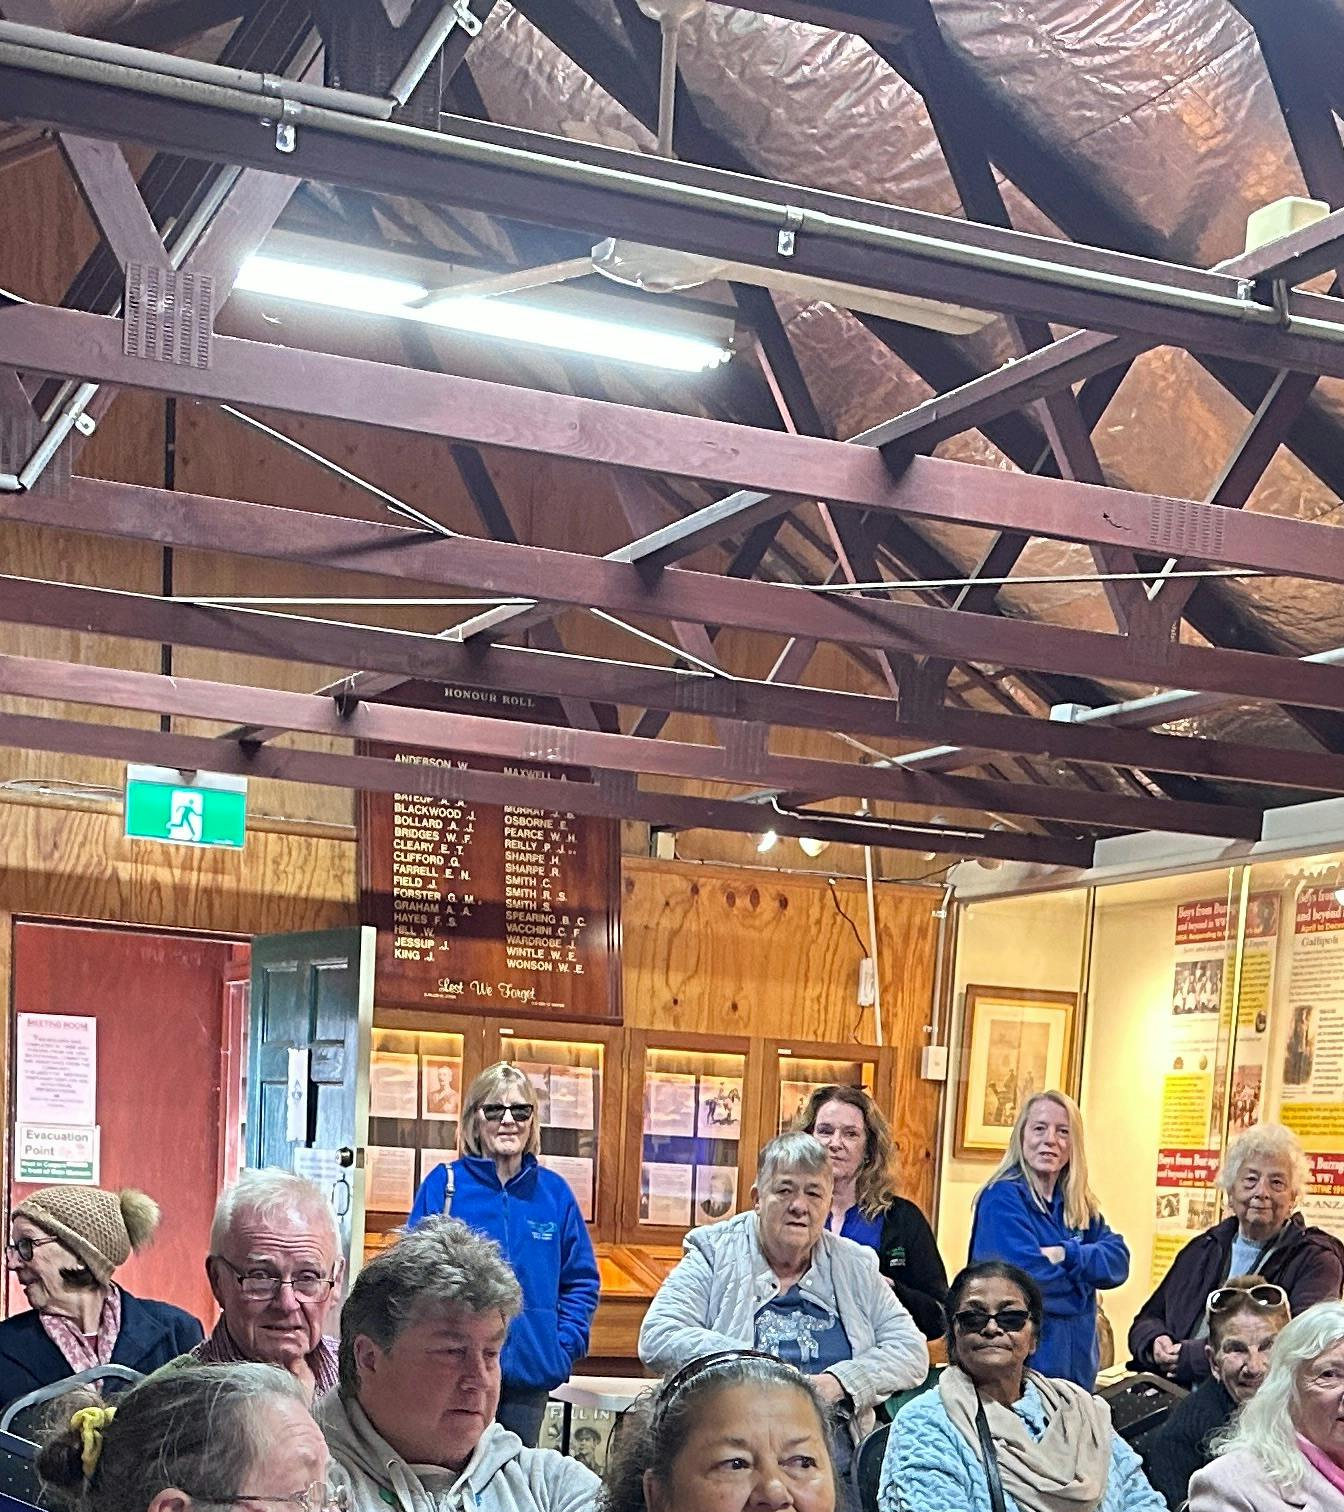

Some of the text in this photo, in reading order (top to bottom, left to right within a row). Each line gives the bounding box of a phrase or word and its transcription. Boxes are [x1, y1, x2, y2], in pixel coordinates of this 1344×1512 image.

[444, 688, 535, 707] HONOUR ROLL
[394, 754, 452, 768] ANDERSON
[394, 802, 462, 818] BLACKWOOD
[394, 815, 443, 829] BOLLARD
[504, 815, 554, 828] OSBORNE
[394, 826, 440, 840] BRIDGES
[504, 827, 544, 840] PEARCE
[394, 838, 434, 852] CLEARY
[504, 839, 537, 850] REILLY
[394, 851, 444, 865] CLIFFORD
[505, 850, 544, 864] SHARPE
[394, 863, 438, 877] FARRELL
[505, 863, 544, 876] SHARPE
[394, 875, 422, 888] FIELD
[506, 875, 536, 886] SMITH
[394, 888, 441, 900] FORSTER
[506, 886, 536, 898] SMITH
[394, 900, 440, 912] GRAHAM
[506, 898, 536, 910] SMITH
[394, 912, 428, 924] HAYES
[506, 910, 556, 924] SPEARING
[1313, 906, 1342, 923] beyond
[506, 922, 552, 936] VACCHINI
[394, 936, 435, 949] JESSUP
[506, 934, 562, 948] WARDROBE
[1302, 936, 1338, 947] Gallipoli
[394, 948, 420, 960] KING
[506, 946, 544, 958] WINTLE
[506, 958, 552, 972] WONSON
[438, 978, 464, 994] Lest
[470, 980, 493, 996] We
[498, 982, 536, 1003] Forget
[26, 1130, 88, 1142] Evacuation
[25, 1145, 54, 1156] Point
